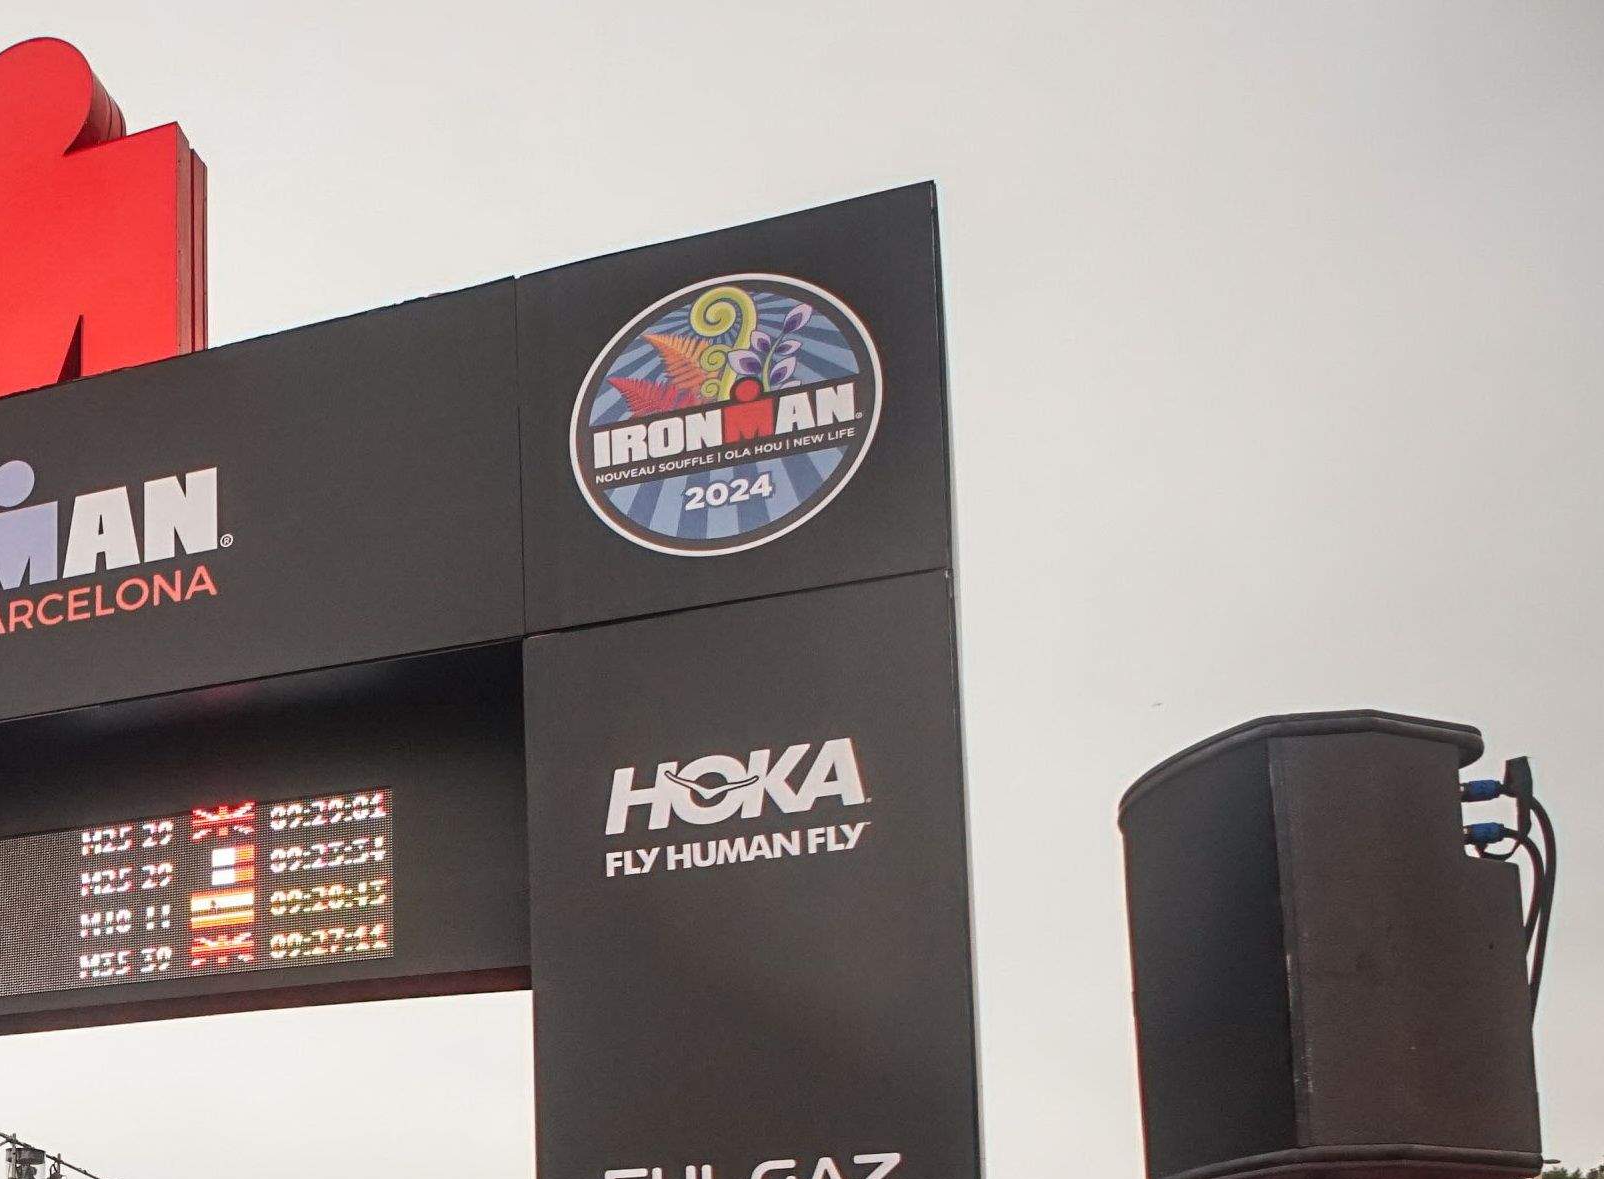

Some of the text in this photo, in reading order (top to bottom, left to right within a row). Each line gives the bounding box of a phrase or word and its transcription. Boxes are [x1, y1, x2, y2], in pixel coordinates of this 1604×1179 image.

[593, 377, 855, 469] IRONMAN
[595, 426, 856, 484] NOUVEAU SOUFFLE OLA HOU NEW LIFE
[685, 473, 773, 511] 2024
[605, 737, 866, 835] HOKA
[606, 822, 868, 877] FLY HUMAN FLY
